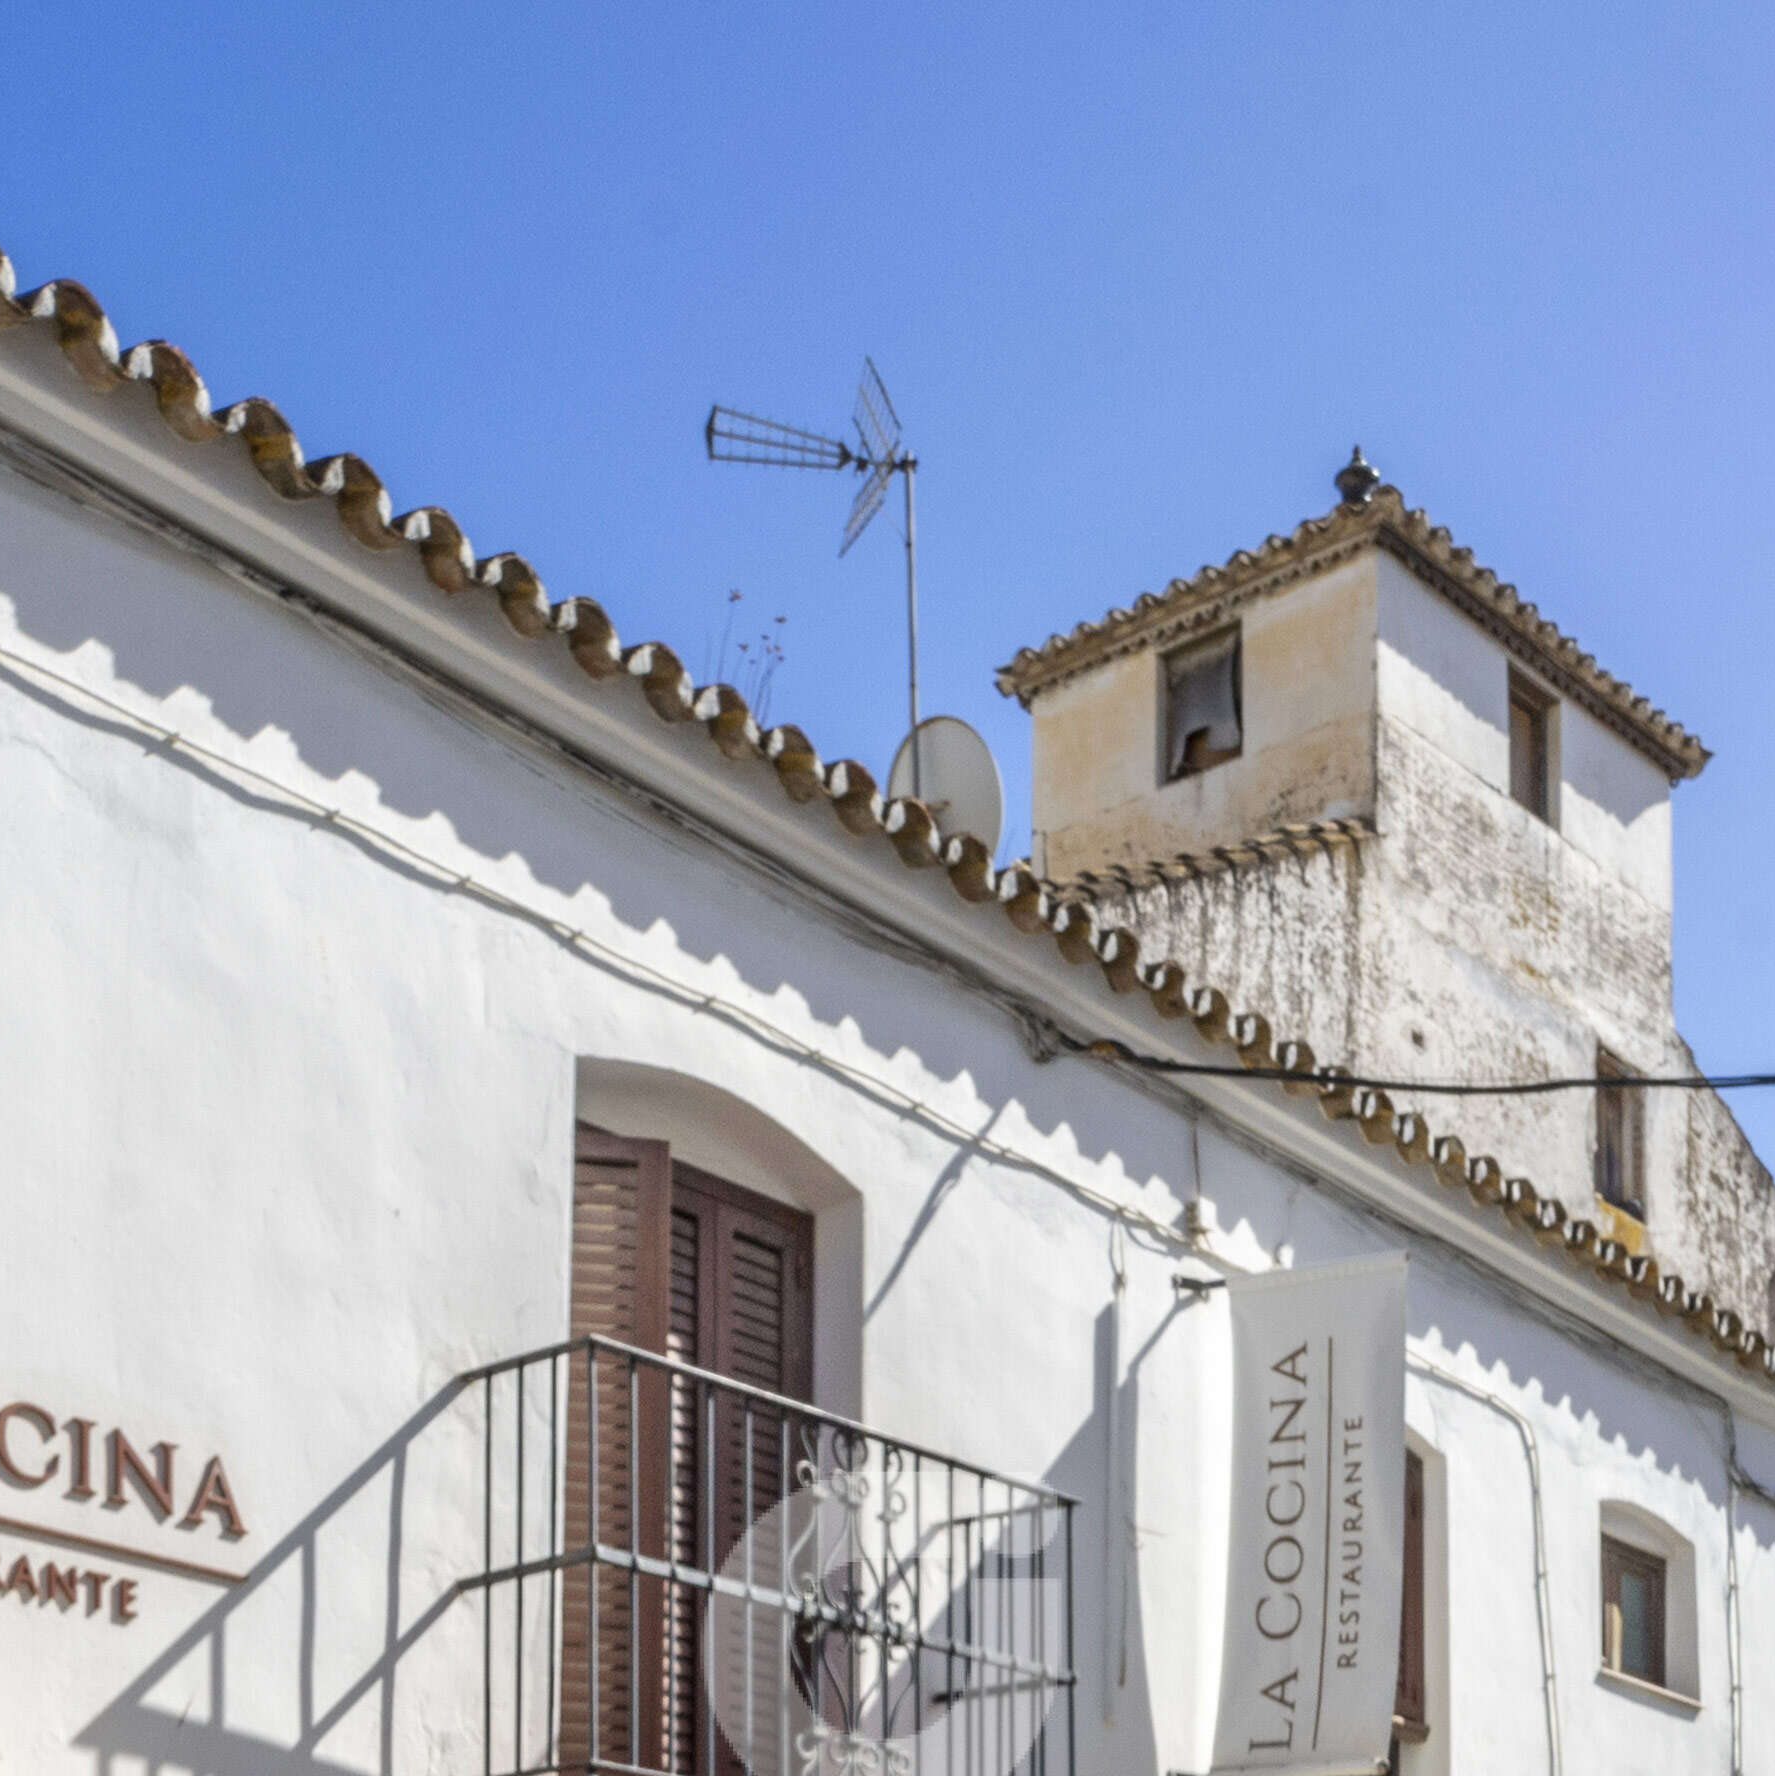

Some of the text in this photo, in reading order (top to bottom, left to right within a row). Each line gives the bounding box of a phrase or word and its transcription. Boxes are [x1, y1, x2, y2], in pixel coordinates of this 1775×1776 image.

[1248, 1340, 1310, 1753] LA COCINA
[1336, 1413, 1365, 1671] RESTAURANTE
